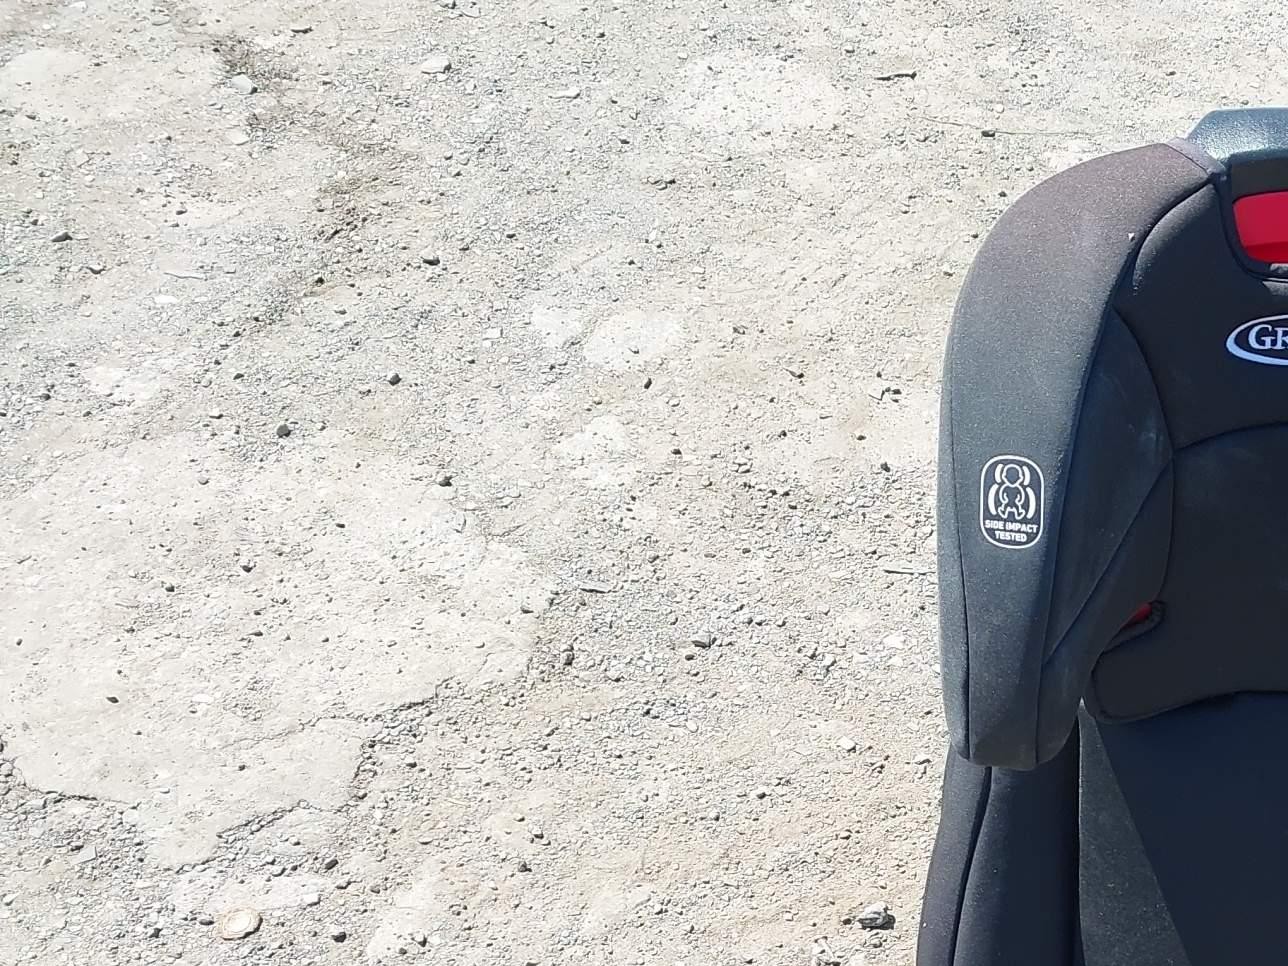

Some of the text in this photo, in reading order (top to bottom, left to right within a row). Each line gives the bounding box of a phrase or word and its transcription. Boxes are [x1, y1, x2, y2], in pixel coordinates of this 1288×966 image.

[985, 519, 1038, 533] SIDE IMPACT
[995, 530, 1027, 542] TESTED
